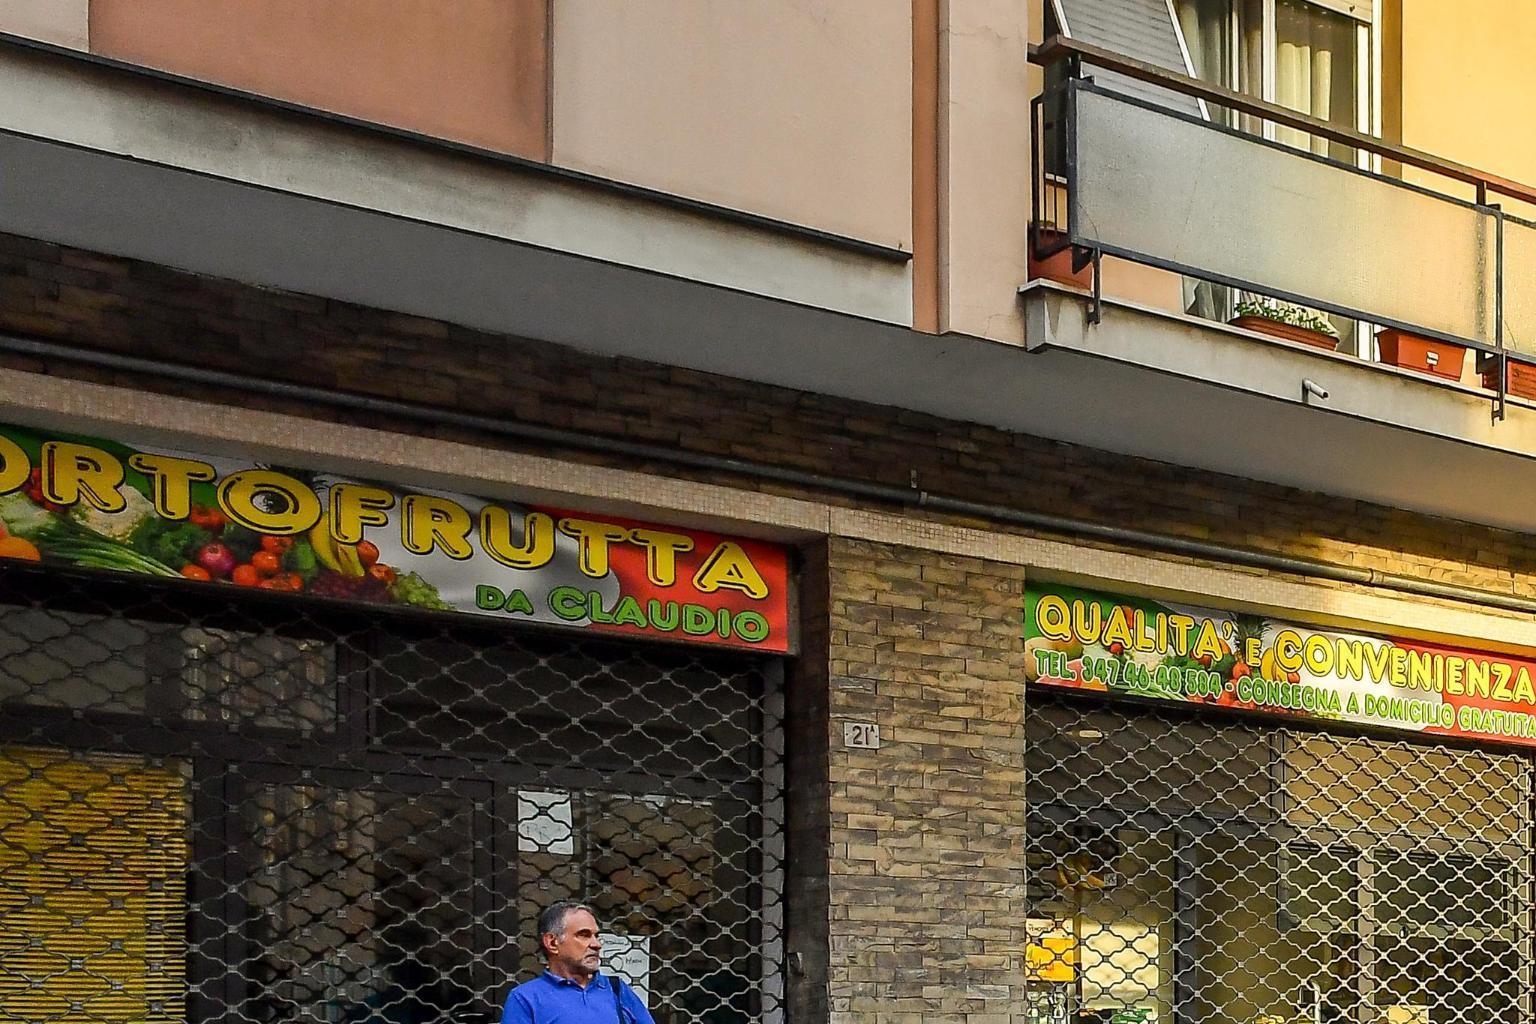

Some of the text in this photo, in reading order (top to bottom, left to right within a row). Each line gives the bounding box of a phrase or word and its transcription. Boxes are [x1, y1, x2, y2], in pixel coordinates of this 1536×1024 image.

[475, 583, 771, 643] DA CLAUDIO
[1035, 594, 1536, 706] QUALITA' E CONVENIENZA
[1033, 649, 1078, 682] TEL.
[1080, 654, 1120, 686] 347
[1122, 659, 1151, 691] 46
[1154, 664, 1183, 694] 48
[1185, 668, 1223, 699] 584
[1238, 674, 1343, 715] CONSEGNA
[1345, 688, 1361, 715] A
[1363, 691, 1455, 730] DOMICILIO
